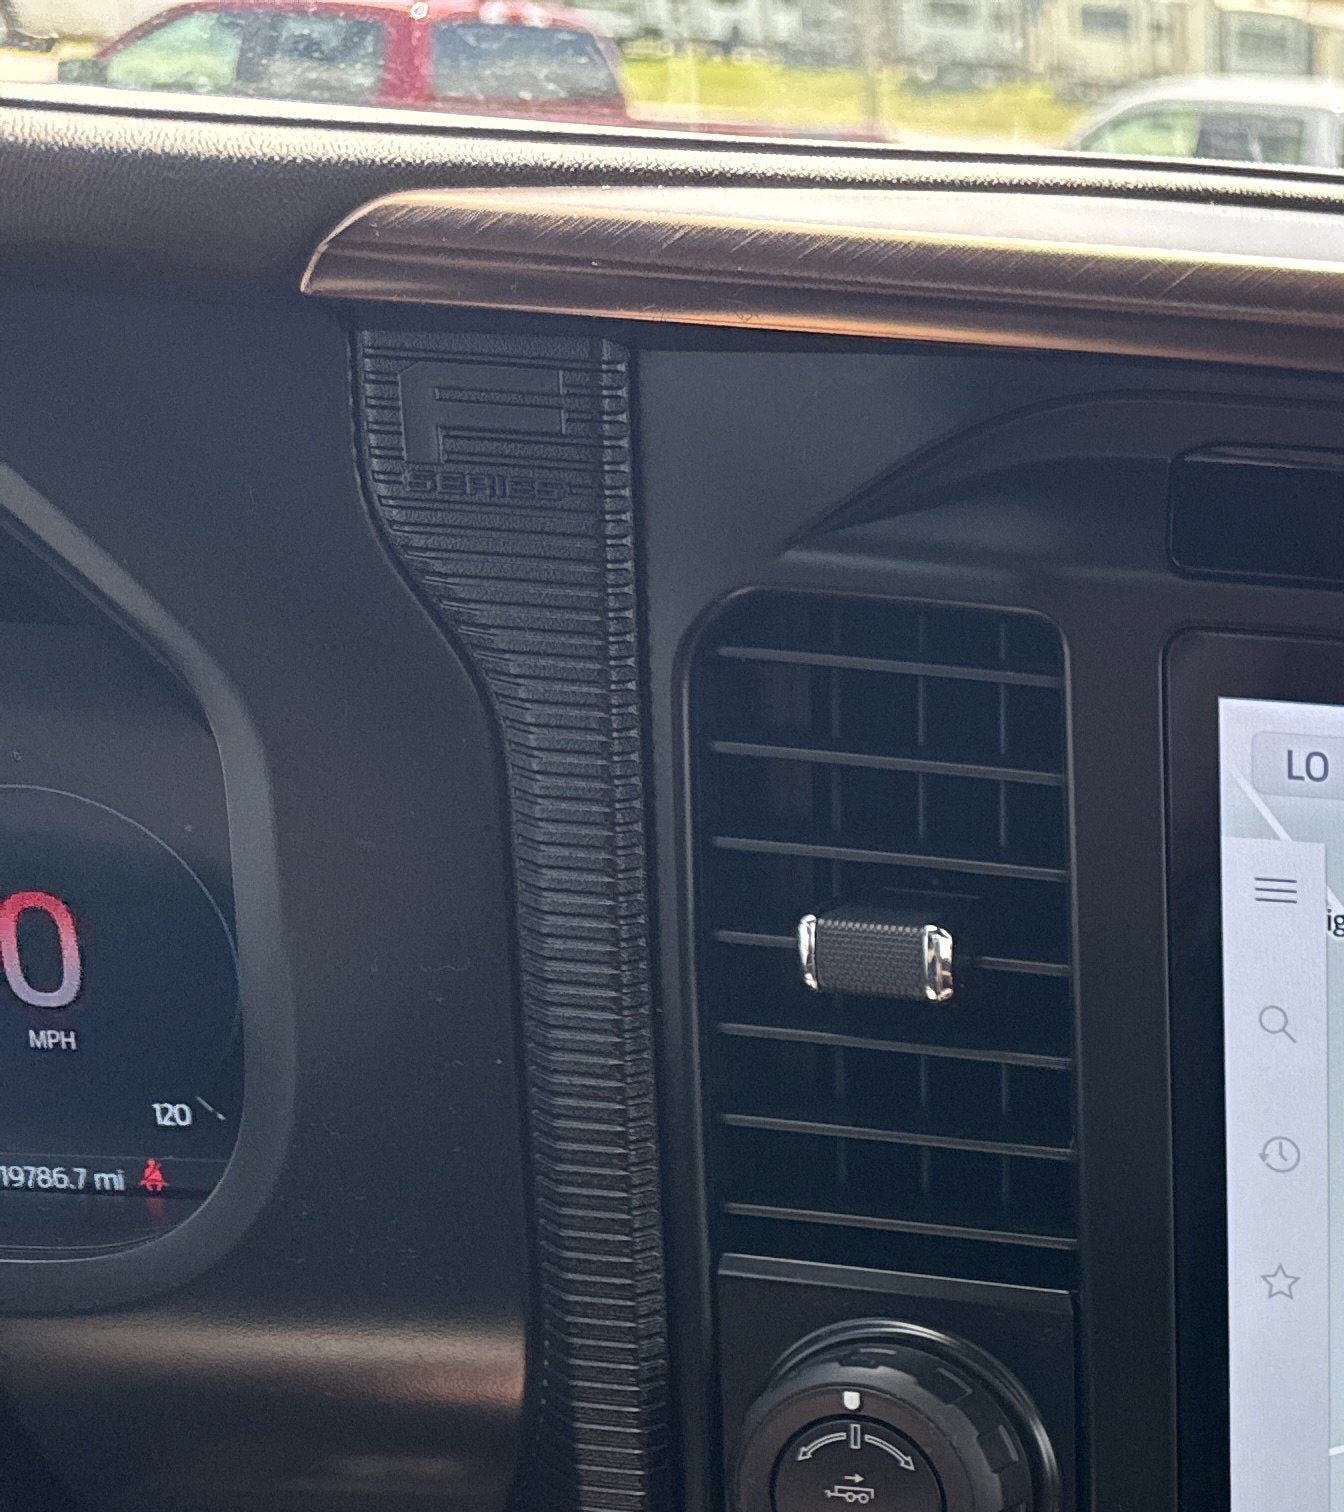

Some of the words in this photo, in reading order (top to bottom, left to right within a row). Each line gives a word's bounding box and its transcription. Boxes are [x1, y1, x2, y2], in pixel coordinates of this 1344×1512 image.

[1286, 748, 1330, 783] LO
[0, 889, 83, 1009] 0
[28, 1029, 77, 1050] MPH
[152, 1102, 193, 1127] 120
[0, 1165, 87, 1190] 19786.7
[93, 1169, 125, 1191] mi
